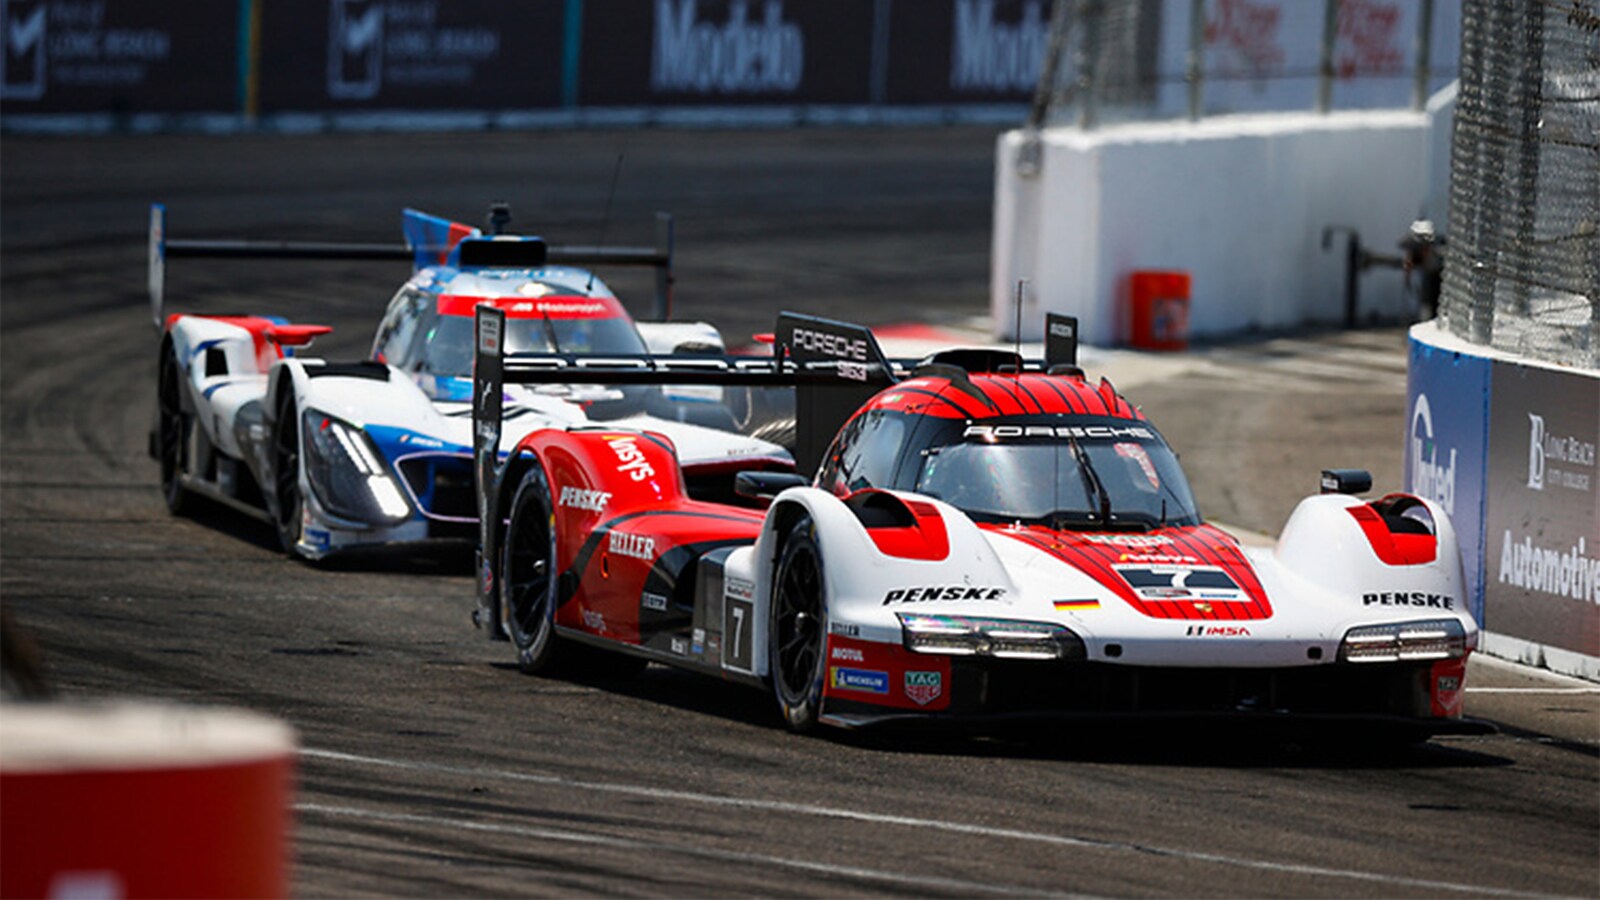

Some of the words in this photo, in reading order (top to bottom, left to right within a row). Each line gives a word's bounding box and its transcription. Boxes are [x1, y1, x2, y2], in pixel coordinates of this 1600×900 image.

[654, 0, 803, 91] Modelo
[793, 328, 868, 360] PORSCHE
[963, 424, 1155, 440] PORSCHE
[558, 486, 612, 512] PENSKE
[608, 530, 654, 560] HELLER
[882, 588, 1006, 606] PENSKE
[1363, 592, 1454, 610] PENSKE
[733, 607, 744, 658] 7
[1206, 626, 1251, 637] IMSA
[831, 647, 864, 661] MOTUL
[908, 673, 938, 685] TAG
